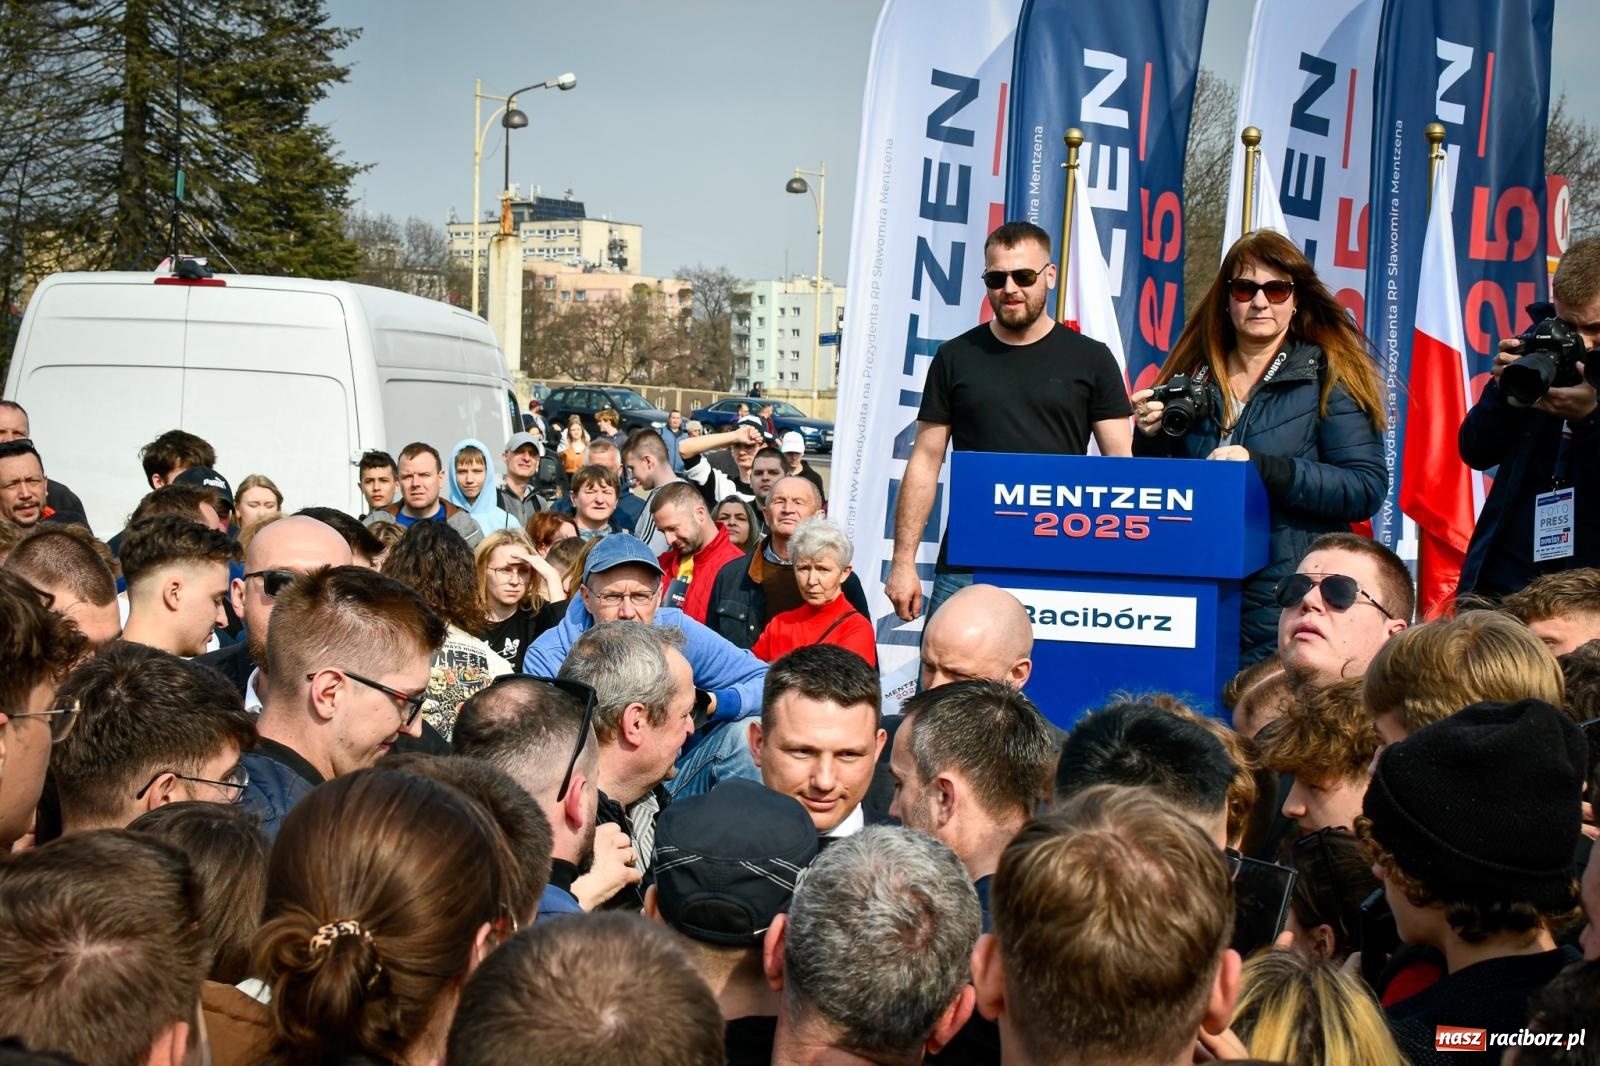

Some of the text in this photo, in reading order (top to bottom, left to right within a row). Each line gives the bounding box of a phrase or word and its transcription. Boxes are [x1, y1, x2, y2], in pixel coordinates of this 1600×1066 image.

[879, 138, 894, 205] Mentzena
[1029, 126, 1044, 194] Mentzena
[1391, 120, 1403, 194] Mentzena
[871, 207, 888, 278] Sławomira
[1387, 198, 1400, 276] Sławomira
[870, 281, 880, 300] RP
[1387, 279, 1399, 301] RP
[862, 304, 879, 378] Prezydenta
[1387, 305, 1399, 389] Prezydenta
[1263, 352, 1287, 382] Canon
[862, 383, 871, 400] na
[853, 403, 869, 475] Kandydata
[849, 479, 858, 502] KW
[994, 483, 1194, 511] MENTZEN
[1033, 512, 1150, 540] 2025
[1383, 499, 1393, 526] KW
[1540, 514, 1569, 528] PRESS
